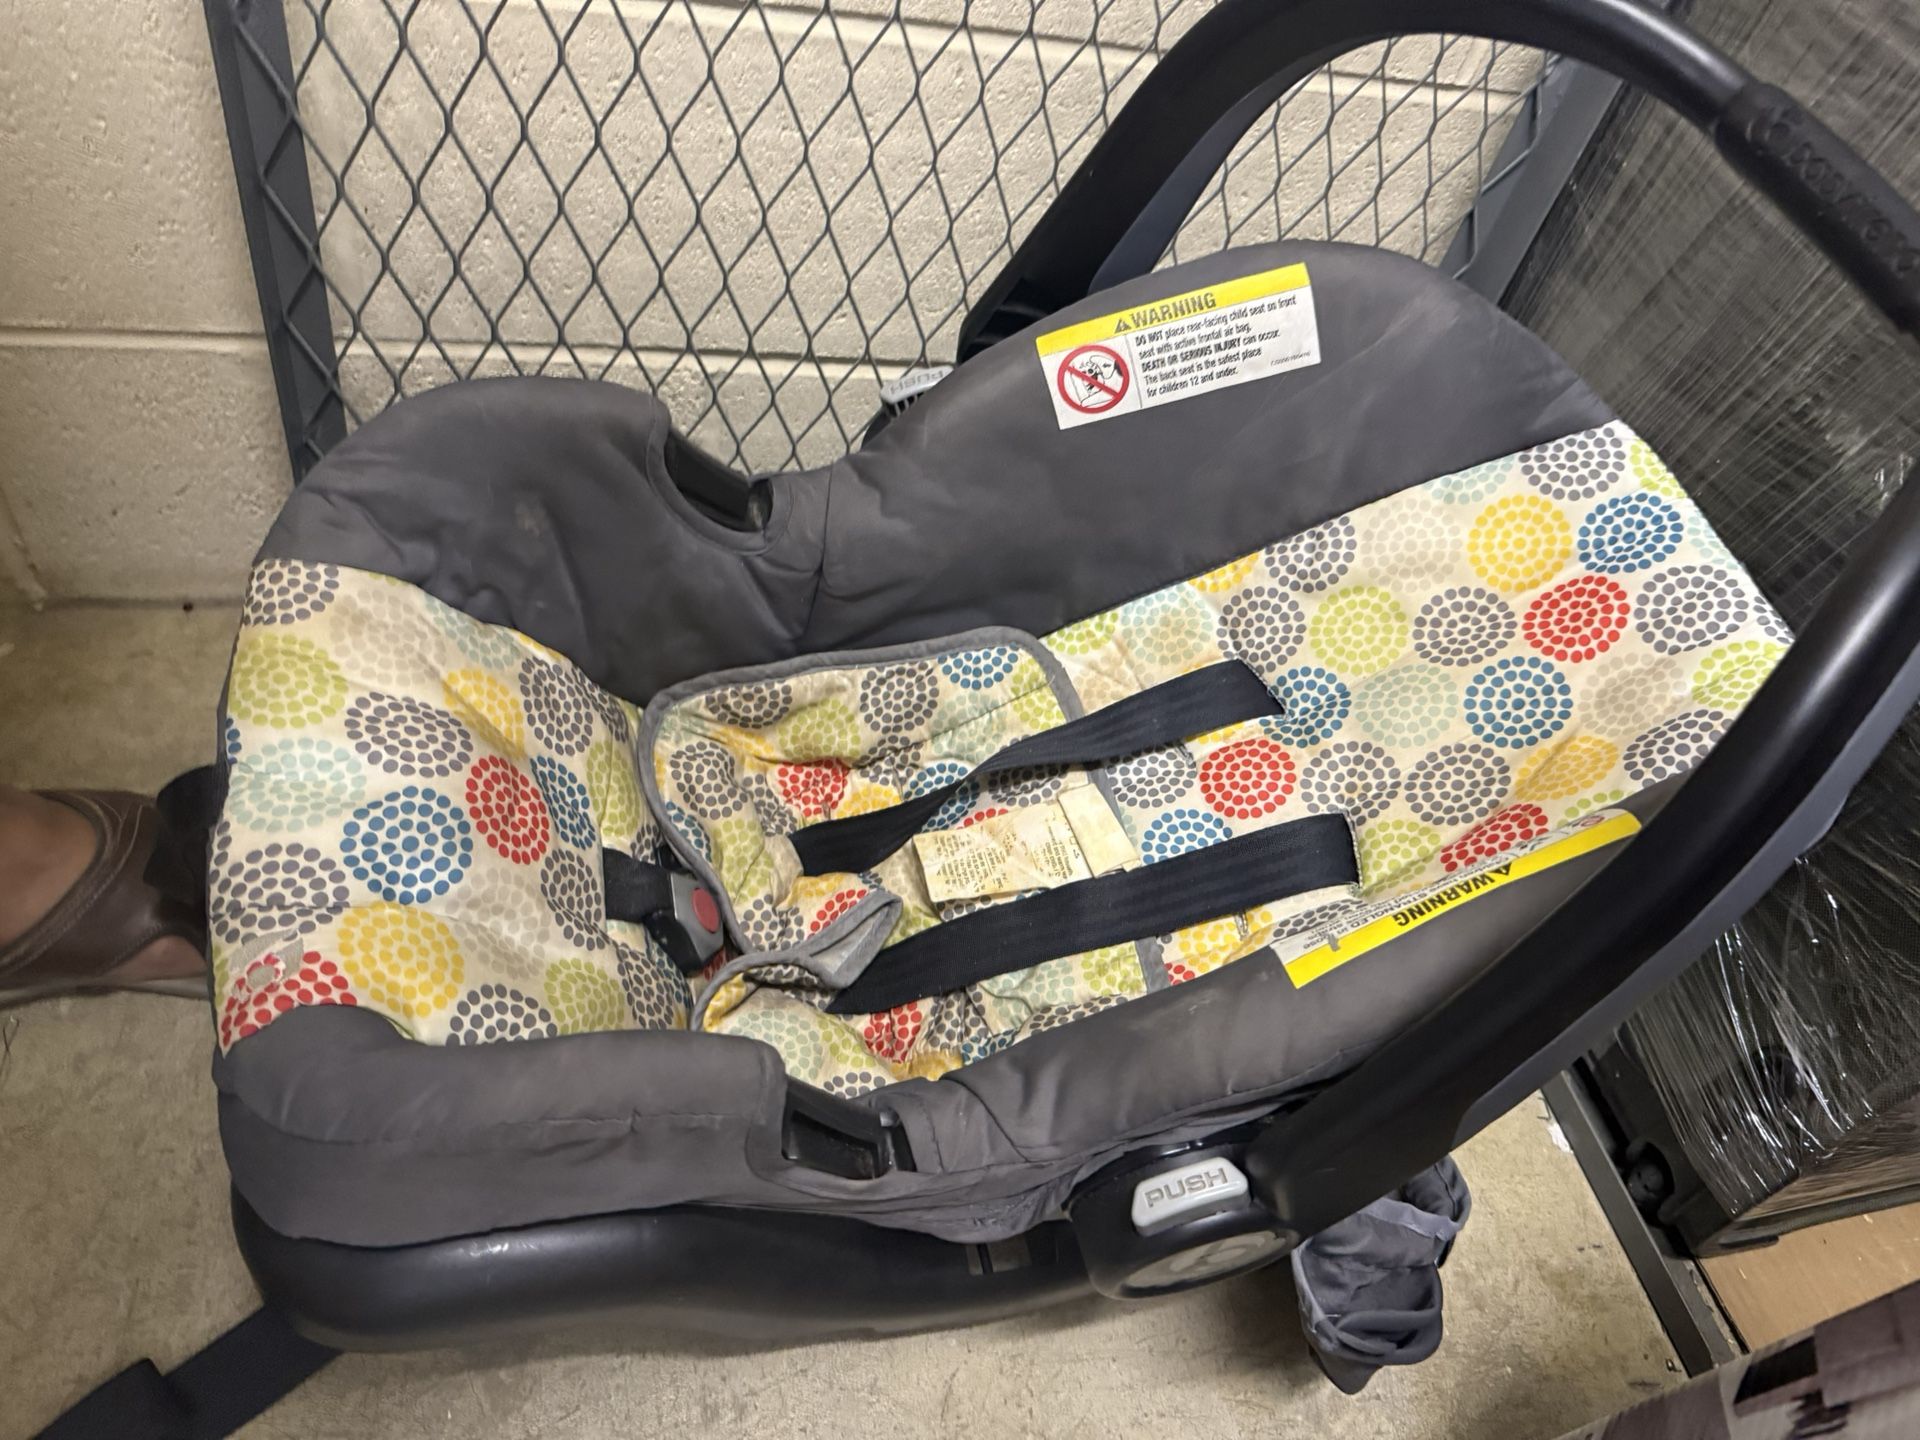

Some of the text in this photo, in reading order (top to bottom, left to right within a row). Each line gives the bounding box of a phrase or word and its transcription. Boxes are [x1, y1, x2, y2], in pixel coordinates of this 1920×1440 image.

[1130, 292, 1216, 329] WARNING
[1134, 294, 1297, 347] DO NOT place rear-facing child seat on front
[1137, 346, 1155, 359] seat
[1155, 341, 1173, 355] with
[1172, 335, 1196, 350] active
[1197, 328, 1222, 343] frontal
[1222, 324, 1234, 336] air
[1140, 358, 1166, 373] DEATH
[1166, 354, 1179, 366] OR
[1179, 345, 1213, 362] SERIOUS
[1213, 337, 1241, 353] INJURY
[1241, 334, 1257, 345] can
[890, 371, 944, 394] PUSH
[1144, 373, 1158, 385] The
[1158, 368, 1177, 381] back
[1177, 363, 1195, 376] seat
[1195, 361, 1203, 371] is
[1203, 357, 1216, 369] the
[1216, 351, 1240, 365] safest
[1240, 345, 1262, 360] place
[1146, 387, 1157, 397] for
[1158, 378, 1188, 394] children
[1188, 375, 1199, 386] 12
[1199, 371, 1213, 383] and
[1350, 892, 1428, 927] STRANGLED
[1392, 874, 1496, 927] WARNING
[1303, 930, 1336, 949] oose
[1337, 926, 1350, 936] in
[1144, 1168, 1228, 1207] PUSH
